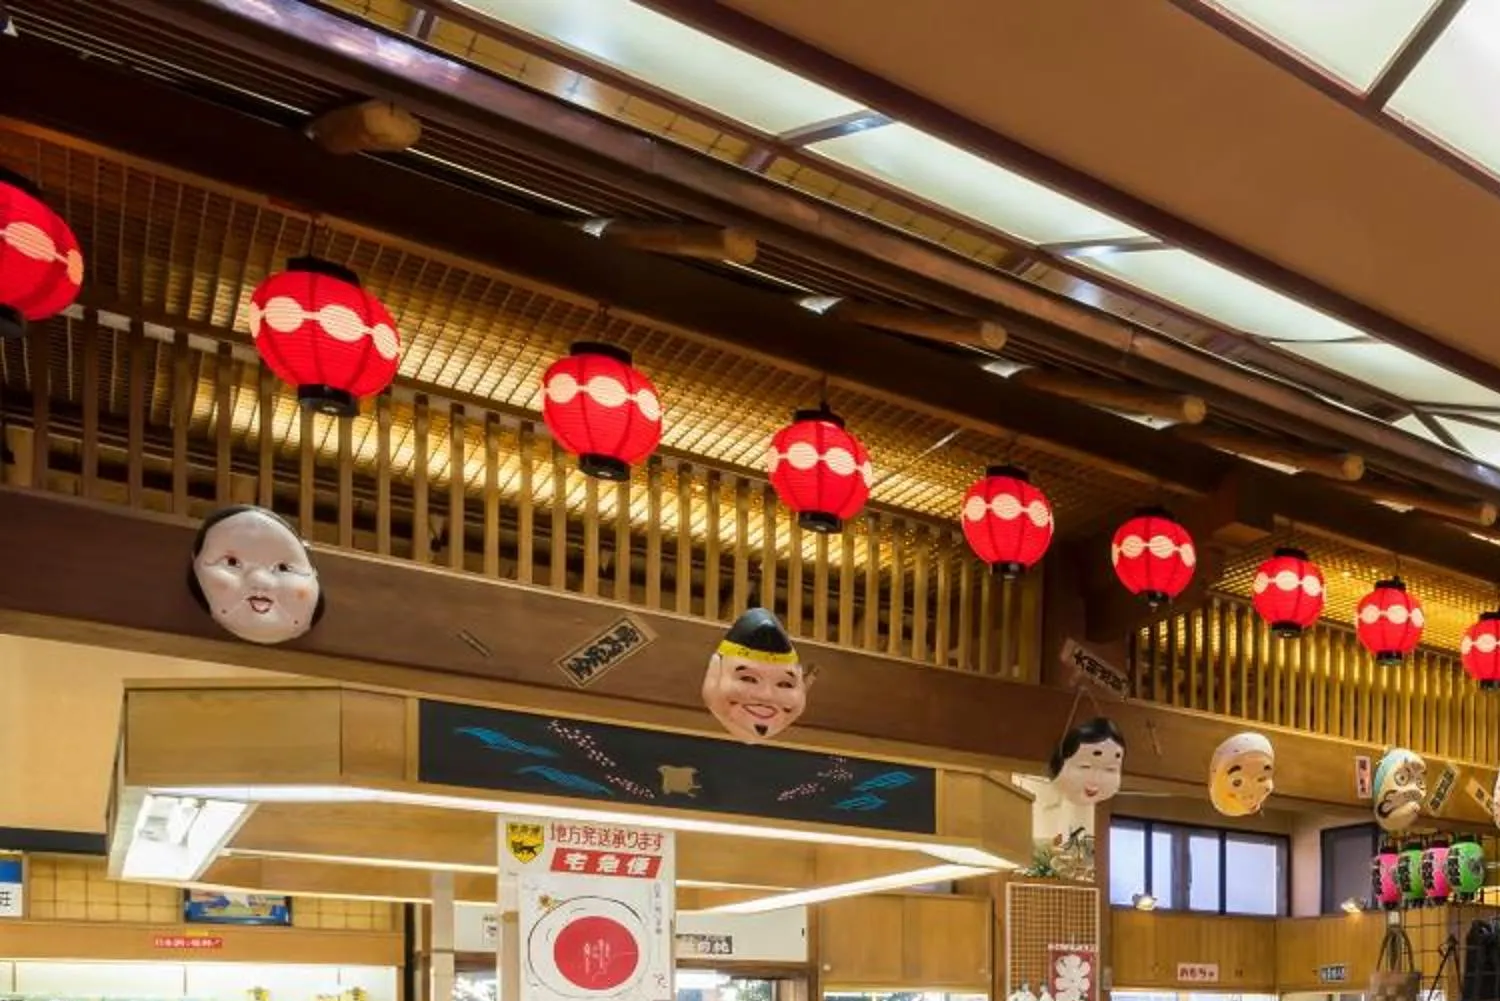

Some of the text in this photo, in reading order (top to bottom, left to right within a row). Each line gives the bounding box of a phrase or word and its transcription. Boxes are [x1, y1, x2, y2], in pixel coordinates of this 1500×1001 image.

[550, 822, 665, 852] 地方発送承ります
[563, 851, 652, 876] 宅急便
